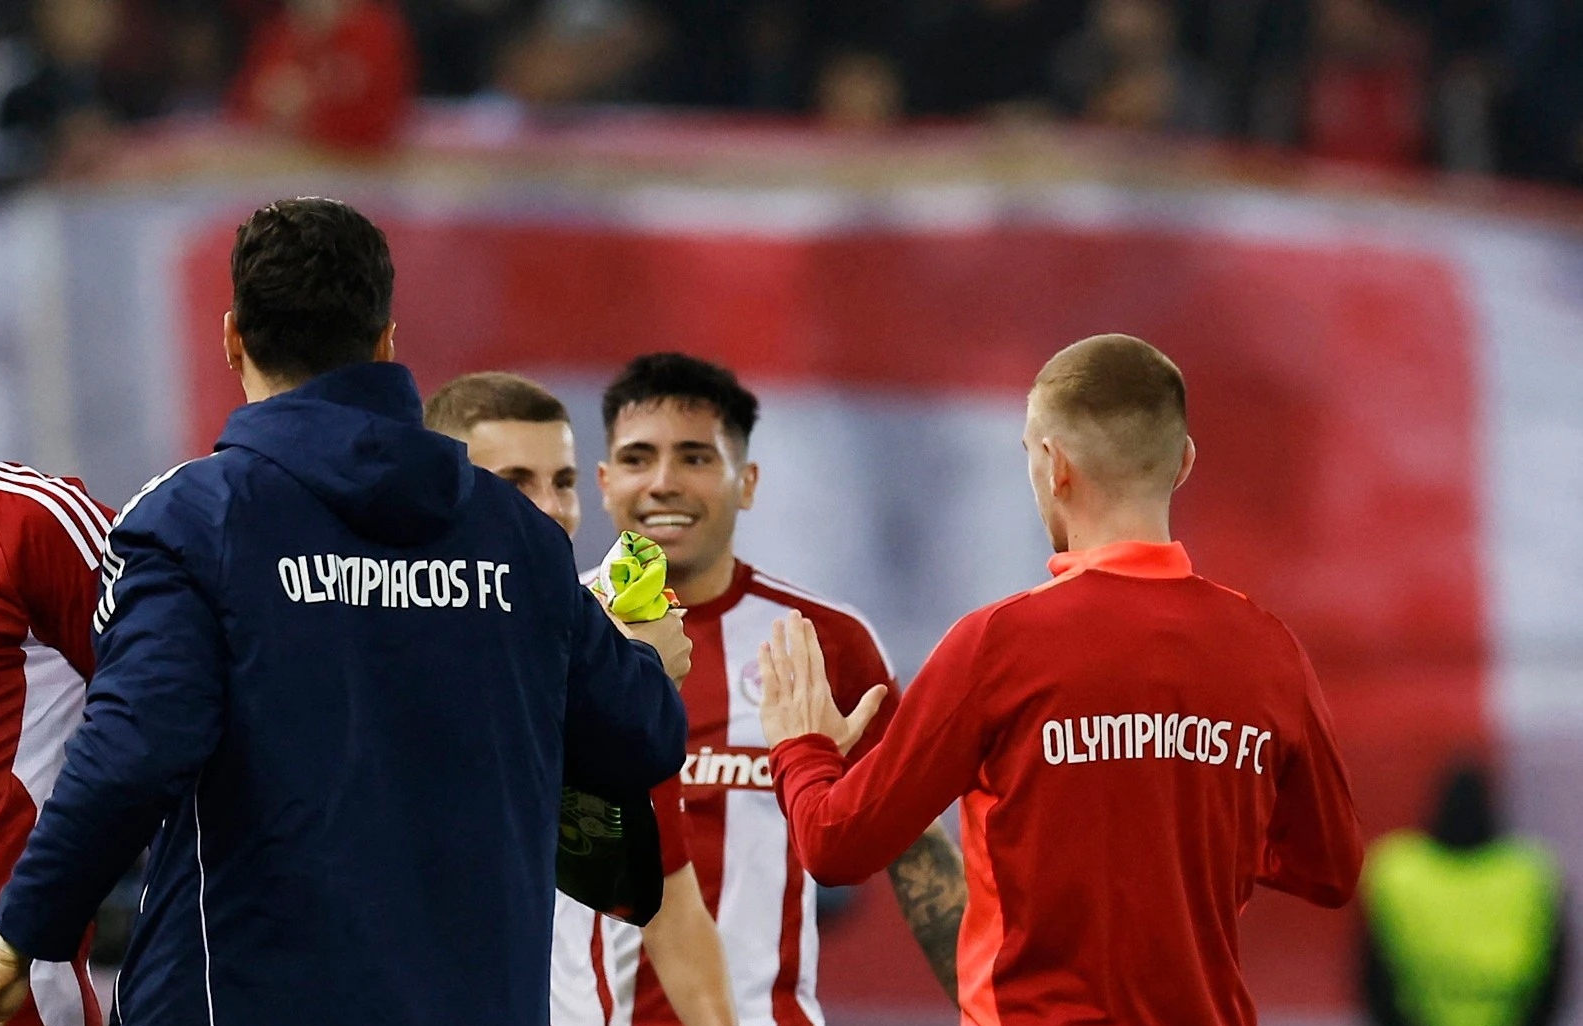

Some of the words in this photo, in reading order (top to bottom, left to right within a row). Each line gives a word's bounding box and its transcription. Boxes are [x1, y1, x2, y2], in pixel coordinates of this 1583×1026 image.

[277, 553, 469, 608] OLYMPIACOS
[477, 560, 512, 612] FC
[1042, 713, 1233, 766] OLYMPIACOS
[1235, 724, 1271, 775] FC
